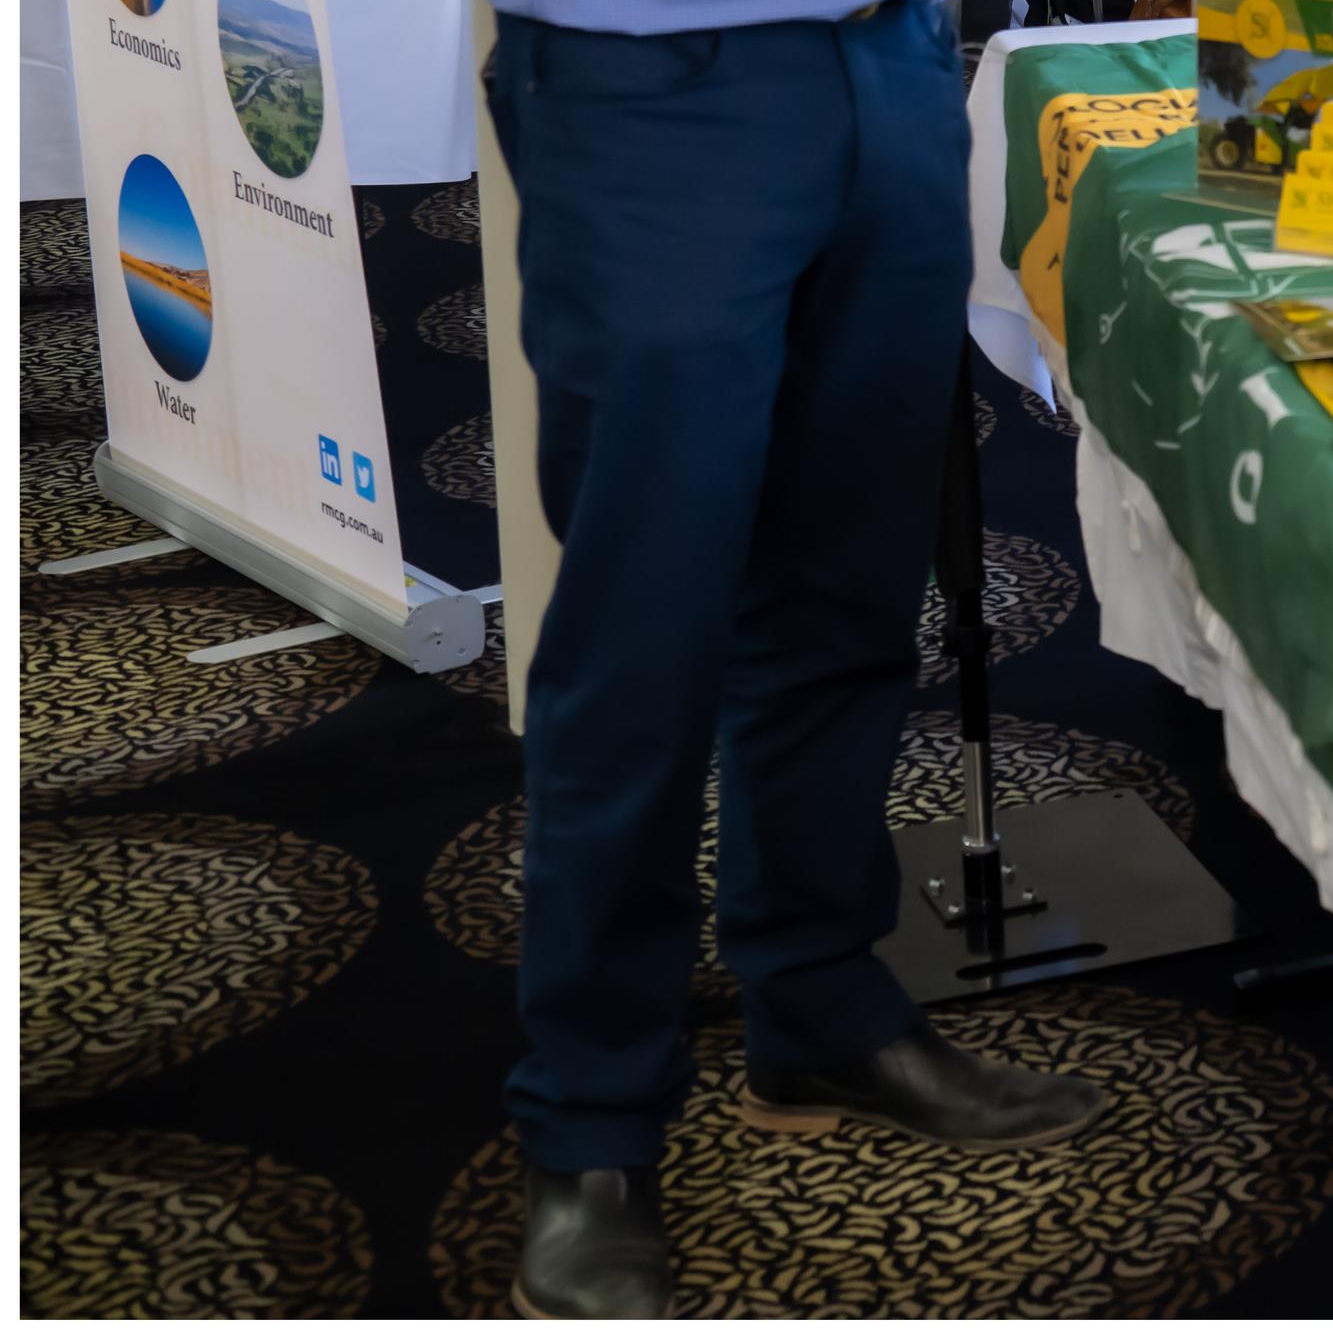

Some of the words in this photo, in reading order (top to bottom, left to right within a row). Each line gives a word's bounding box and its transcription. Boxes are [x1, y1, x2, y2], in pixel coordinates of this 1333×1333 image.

[108, 18, 182, 71] Economics
[232, 171, 335, 238] Environment
[154, 380, 197, 425] Water
[321, 501, 384, 544] rmcg.com.au
